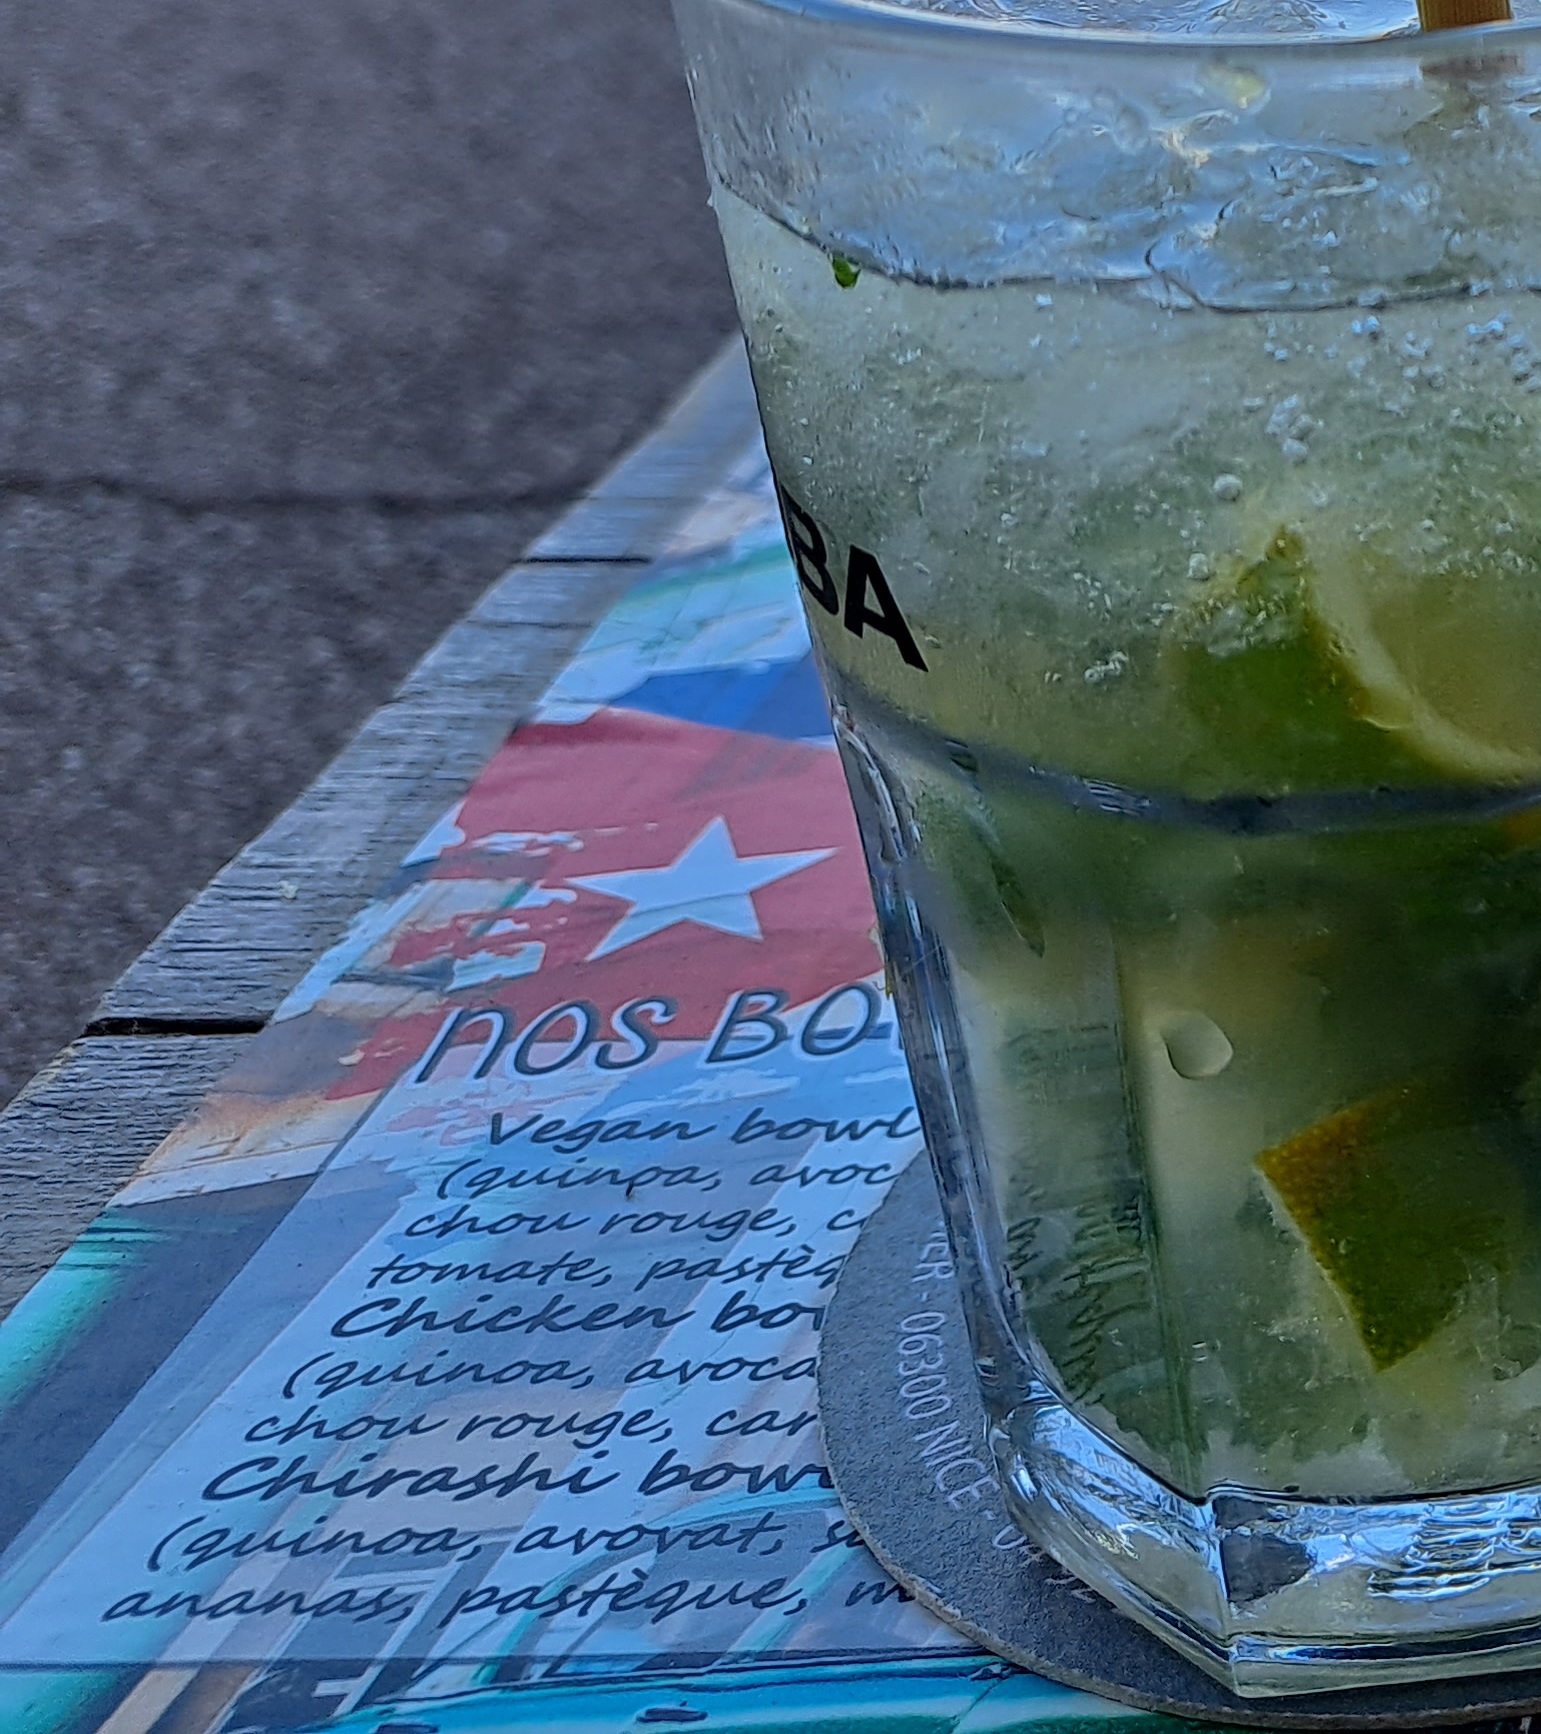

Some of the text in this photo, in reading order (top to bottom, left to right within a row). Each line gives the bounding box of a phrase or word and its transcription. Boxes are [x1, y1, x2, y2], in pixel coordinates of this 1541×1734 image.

[489, 1106, 921, 1155] Vegan bowl
[436, 1155, 899, 1201] (quinoa, avoc
[404, 1202, 593, 1239] chou
[599, 1206, 797, 1244] rouge,
[365, 1242, 850, 1291] tomate, pastèq
[330, 1292, 697, 1339] Chicken
[282, 1349, 595, 1400] (quinoa,
[897, 1310, 952, 1420] 06300
[243, 1405, 448, 1446] chou
[456, 1405, 674, 1451] rouge,
[201, 1448, 622, 1503] Chirashi
[914, 1421, 1002, 1510] NICE
[146, 1516, 480, 1573] (quinoa,
[99, 1582, 419, 1625] ananas,
[436, 1567, 807, 1628] pastèque,
